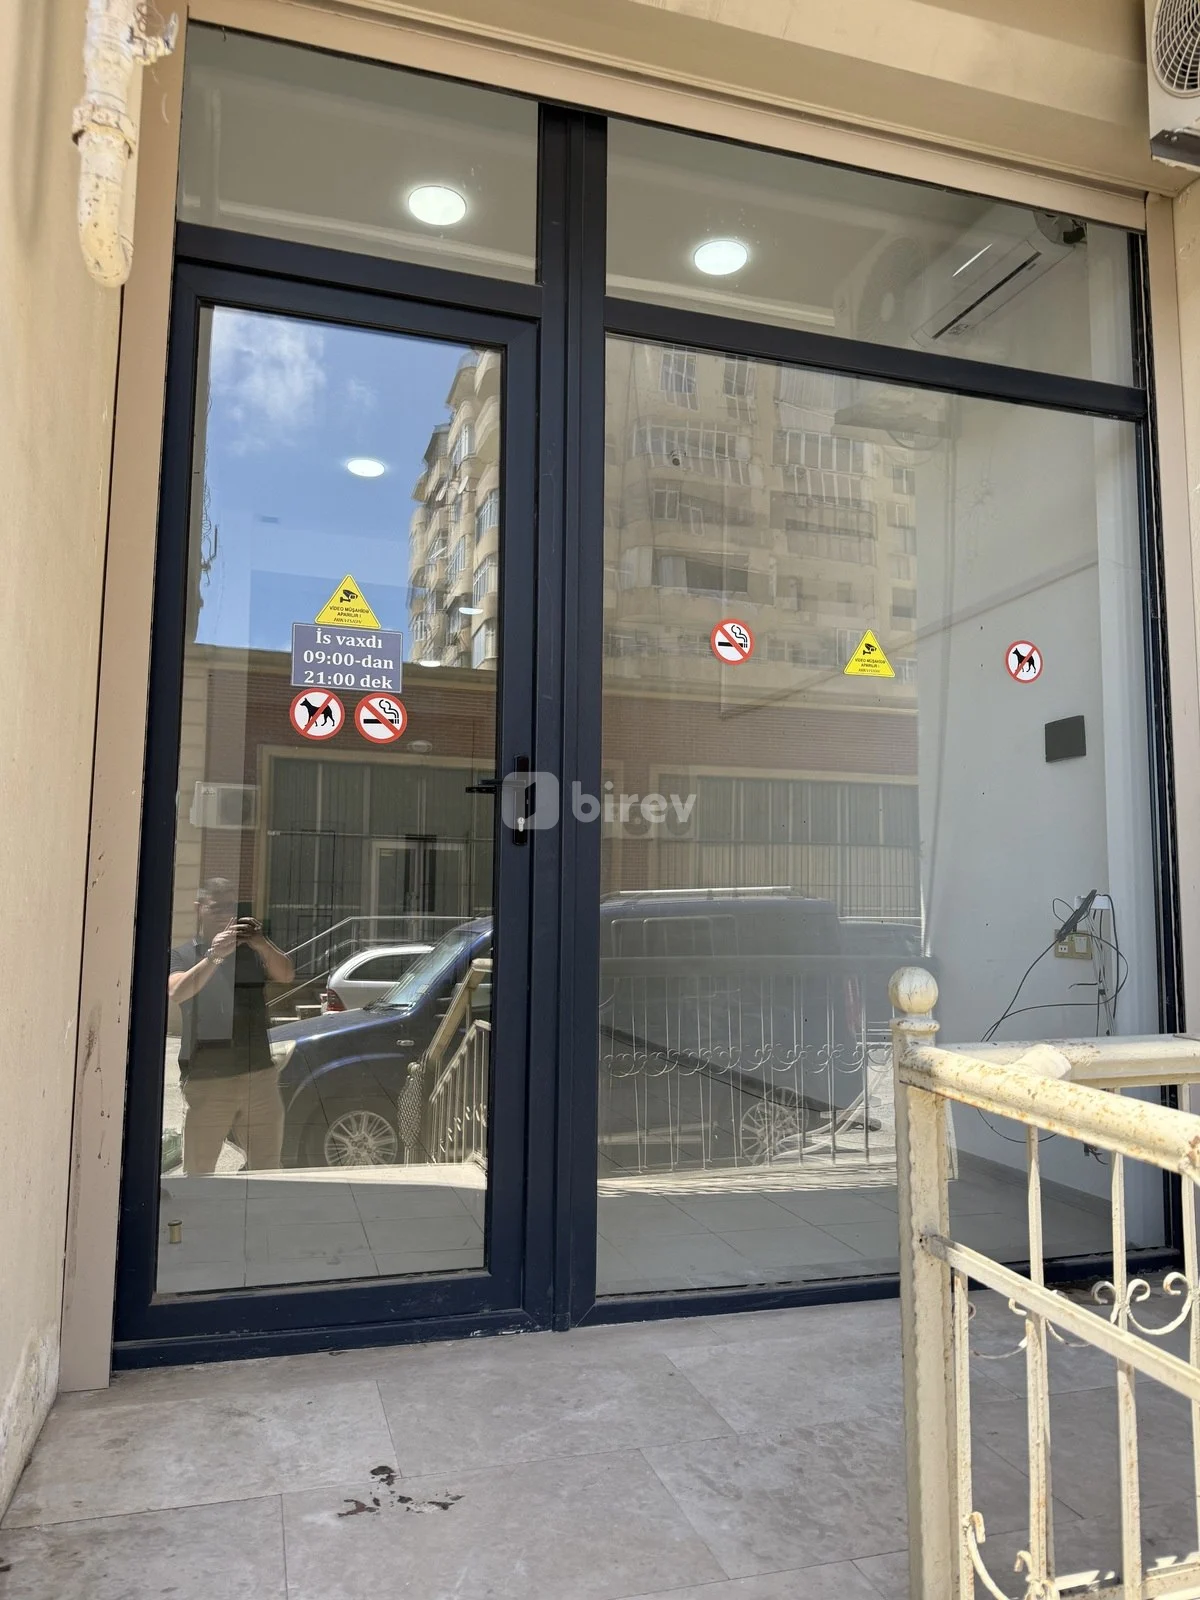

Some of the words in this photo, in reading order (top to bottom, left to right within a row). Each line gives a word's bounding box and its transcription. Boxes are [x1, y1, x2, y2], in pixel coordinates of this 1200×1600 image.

[336, 635, 383, 649] vaxdı
[303, 650, 394, 670] 09:00-dan
[304, 671, 355, 687] 21:00
[360, 675, 393, 690] dek
